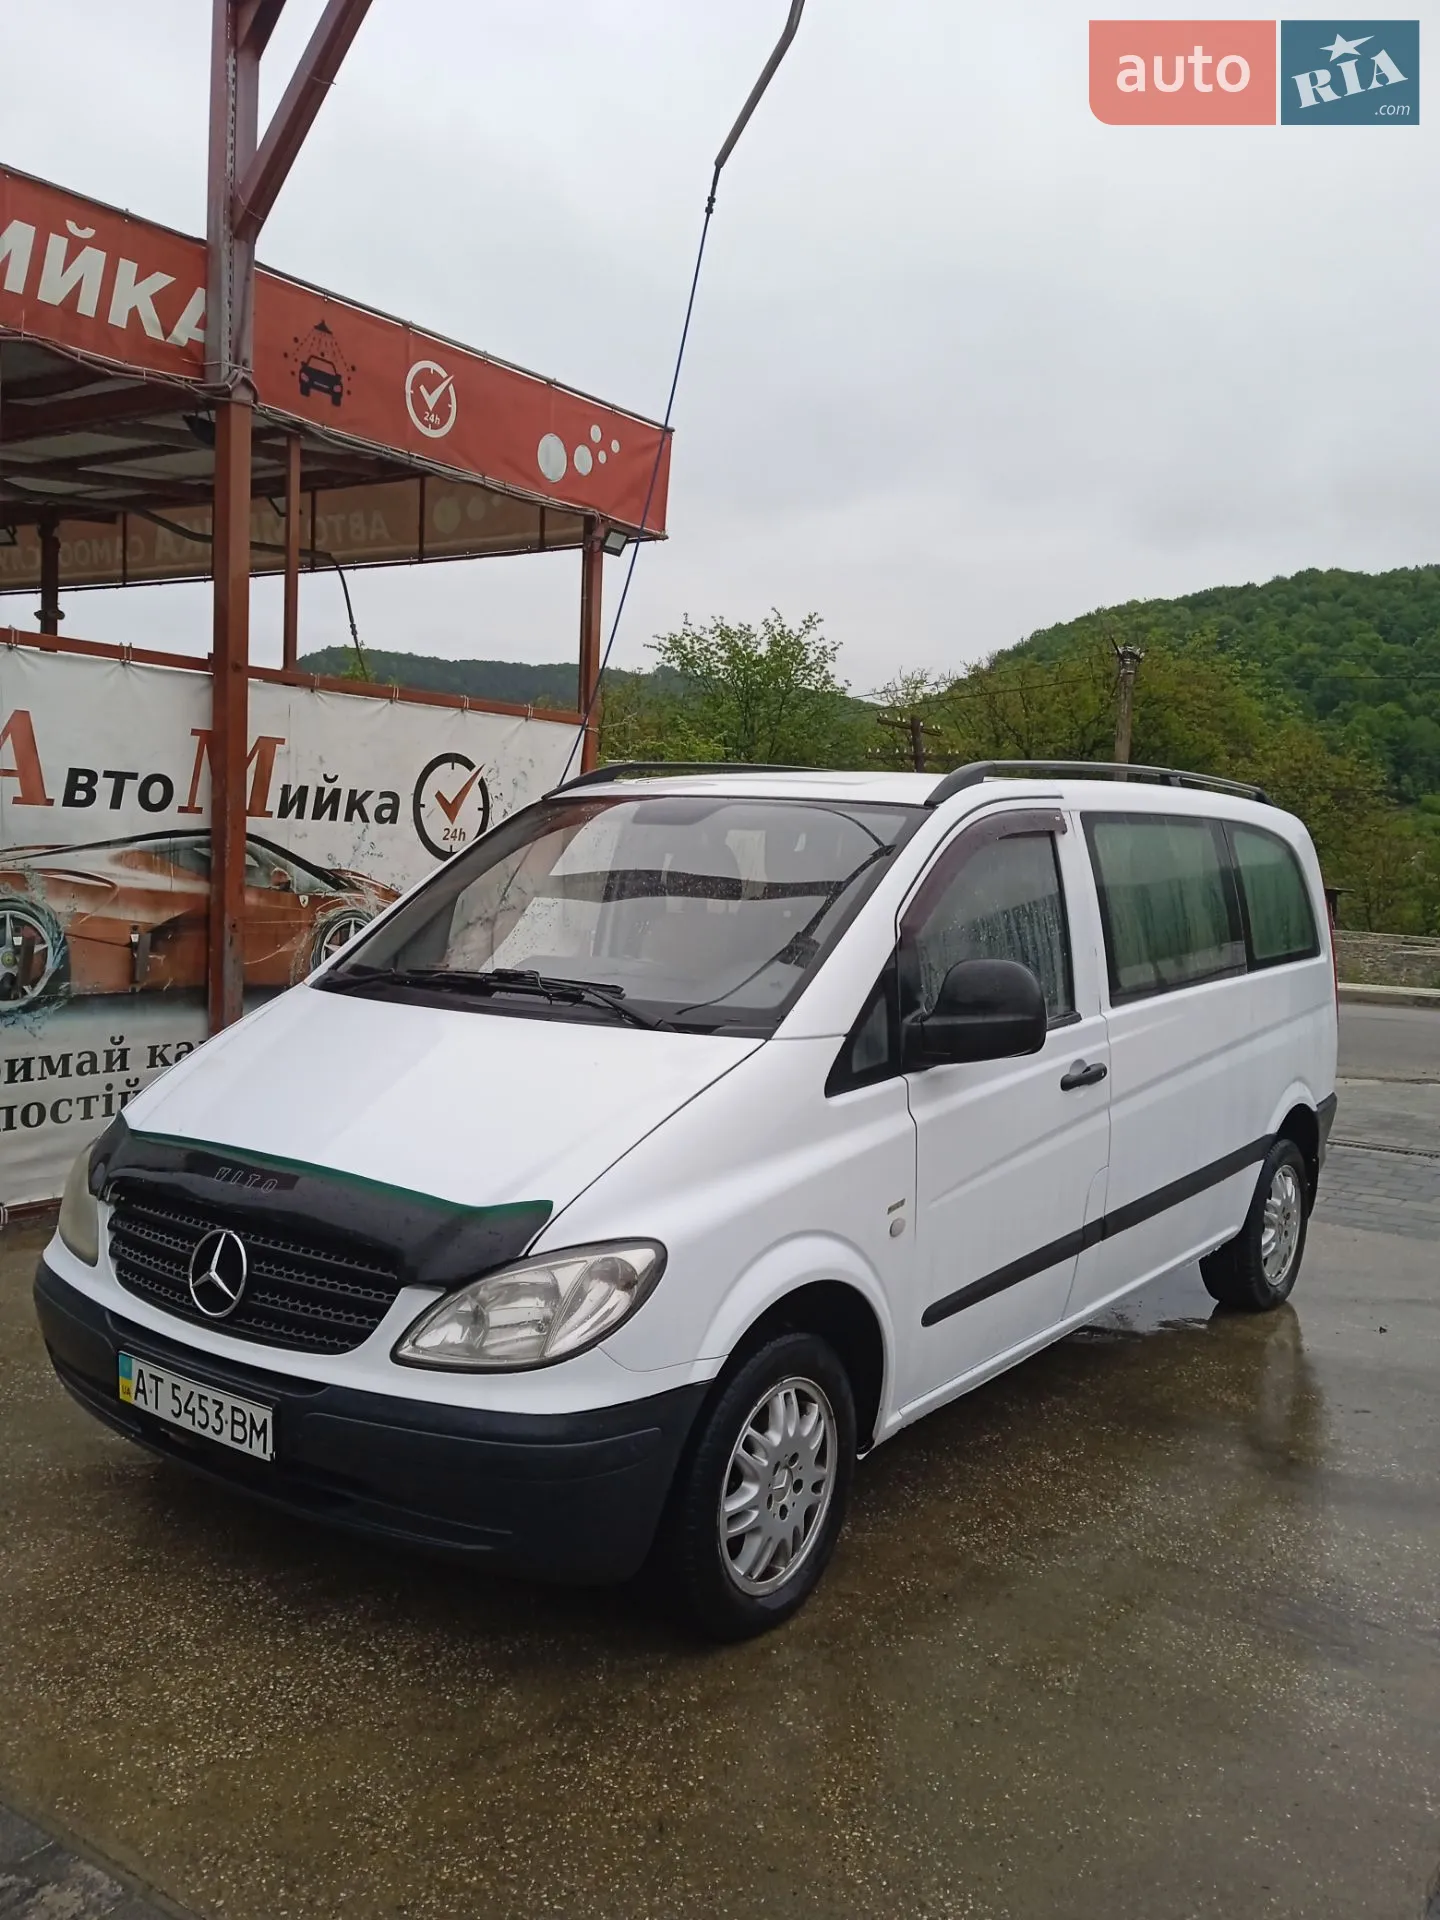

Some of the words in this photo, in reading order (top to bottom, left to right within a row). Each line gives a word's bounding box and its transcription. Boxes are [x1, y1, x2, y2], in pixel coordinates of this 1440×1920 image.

[423, 411, 441, 425] 24h
[442, 827, 467, 842] 24h
[0, 1035, 131, 1084] имай
[146, 1040, 207, 1069] ка
[214, 1166, 278, 1194] VITO
